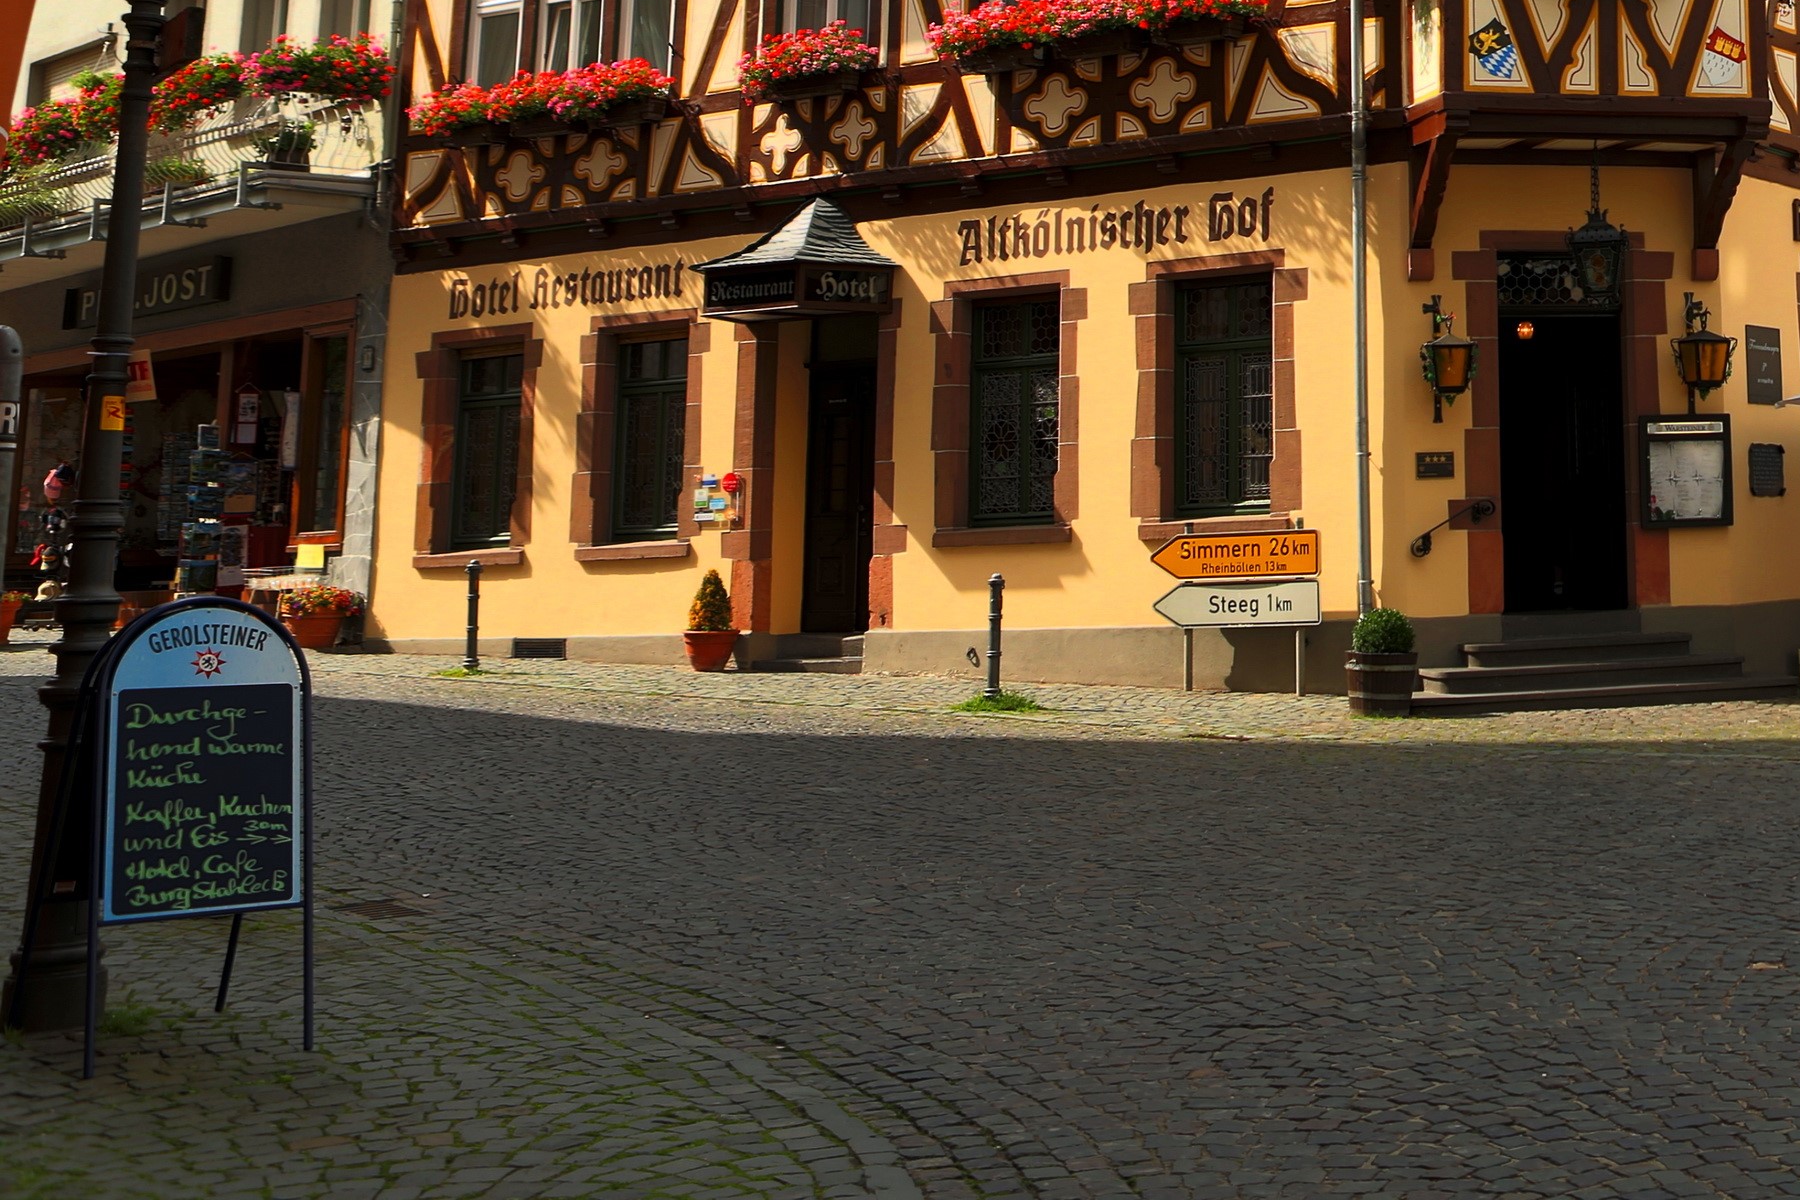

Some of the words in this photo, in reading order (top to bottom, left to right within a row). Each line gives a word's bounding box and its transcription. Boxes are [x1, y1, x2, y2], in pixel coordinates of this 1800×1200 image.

[957, 199, 1190, 266] Altkölnischer
[1208, 186, 1275, 243] Hof
[449, 270, 521, 320] Hotel
[529, 256, 685, 310] Restaurant
[711, 280, 795, 302] Restaurant
[815, 272, 877, 302] Hotel
[1180, 541, 1261, 560] Simmern
[1209, 595, 1259, 618] Steeg
[149, 623, 268, 654] GEROLSTEINER
[126, 761, 207, 789] Küche
[219, 793, 293, 817] Kuchen
[123, 828, 184, 852] und
[190, 823, 230, 848] Eis
